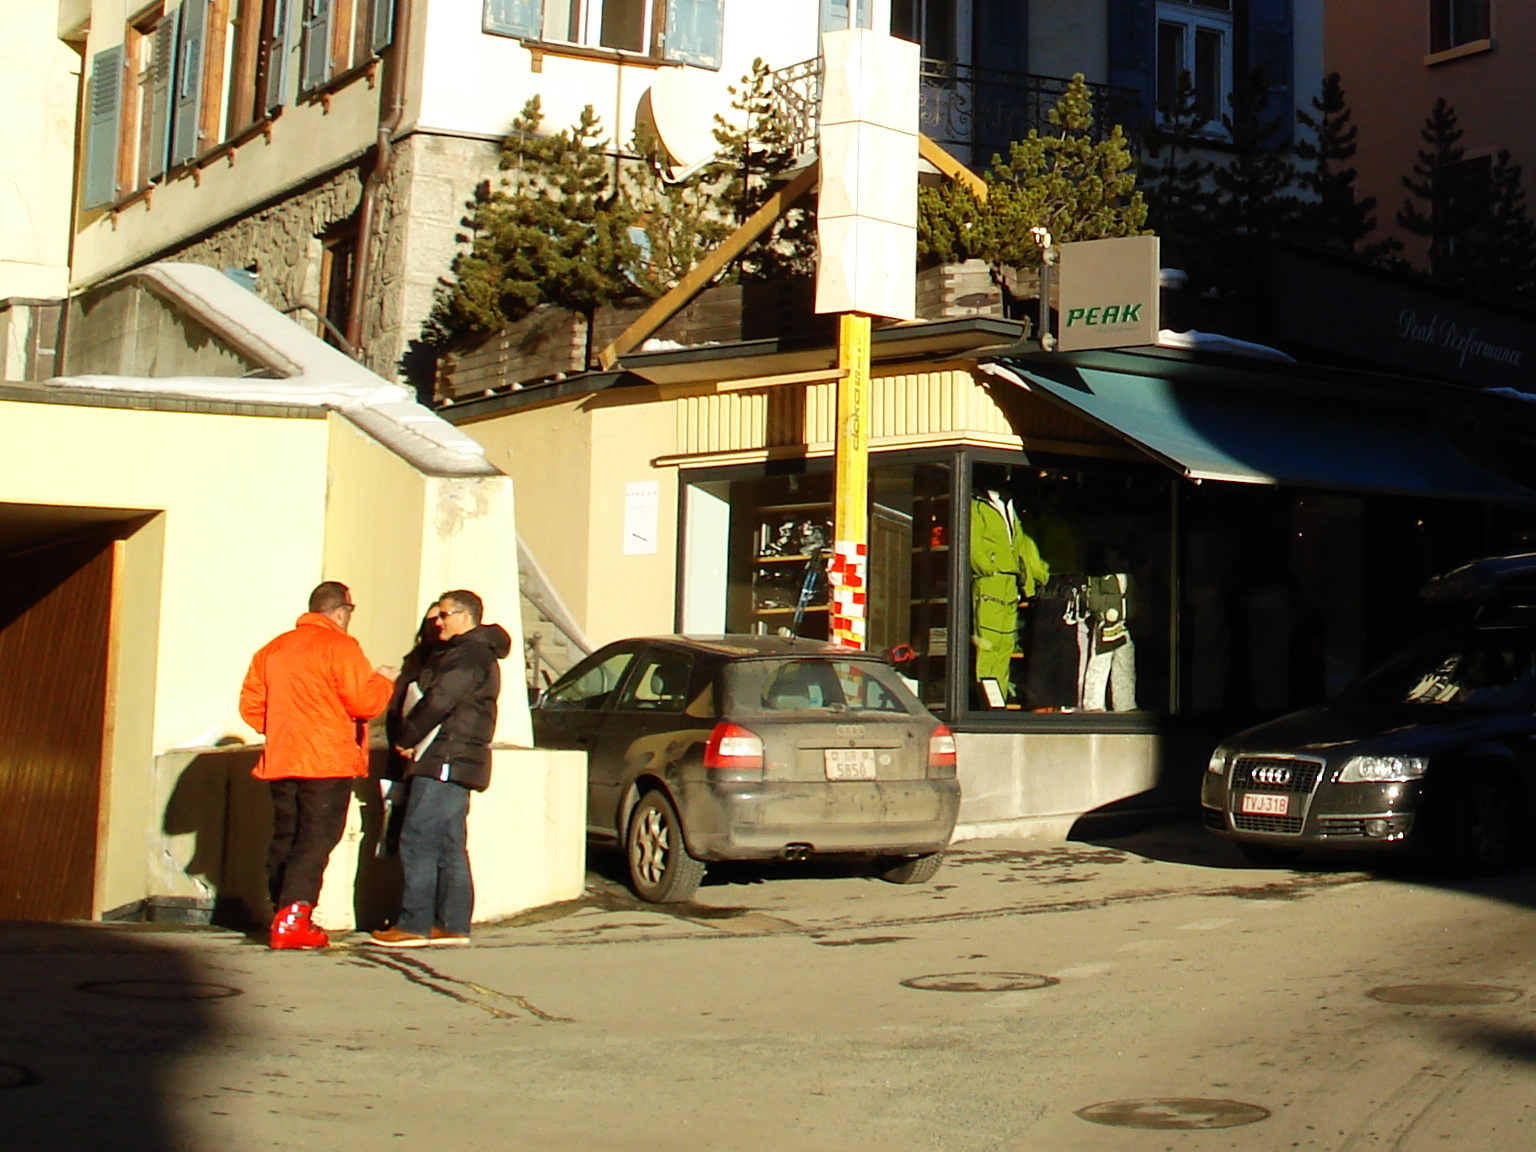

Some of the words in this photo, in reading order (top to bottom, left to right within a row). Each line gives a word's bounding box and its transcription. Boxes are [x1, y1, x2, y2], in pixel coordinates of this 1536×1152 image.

[1066, 303, 1143, 327] PEAK
[1397, 308, 1438, 344] Peak
[1439, 319, 1523, 368] Performance
[837, 762, 866, 777] 5850
